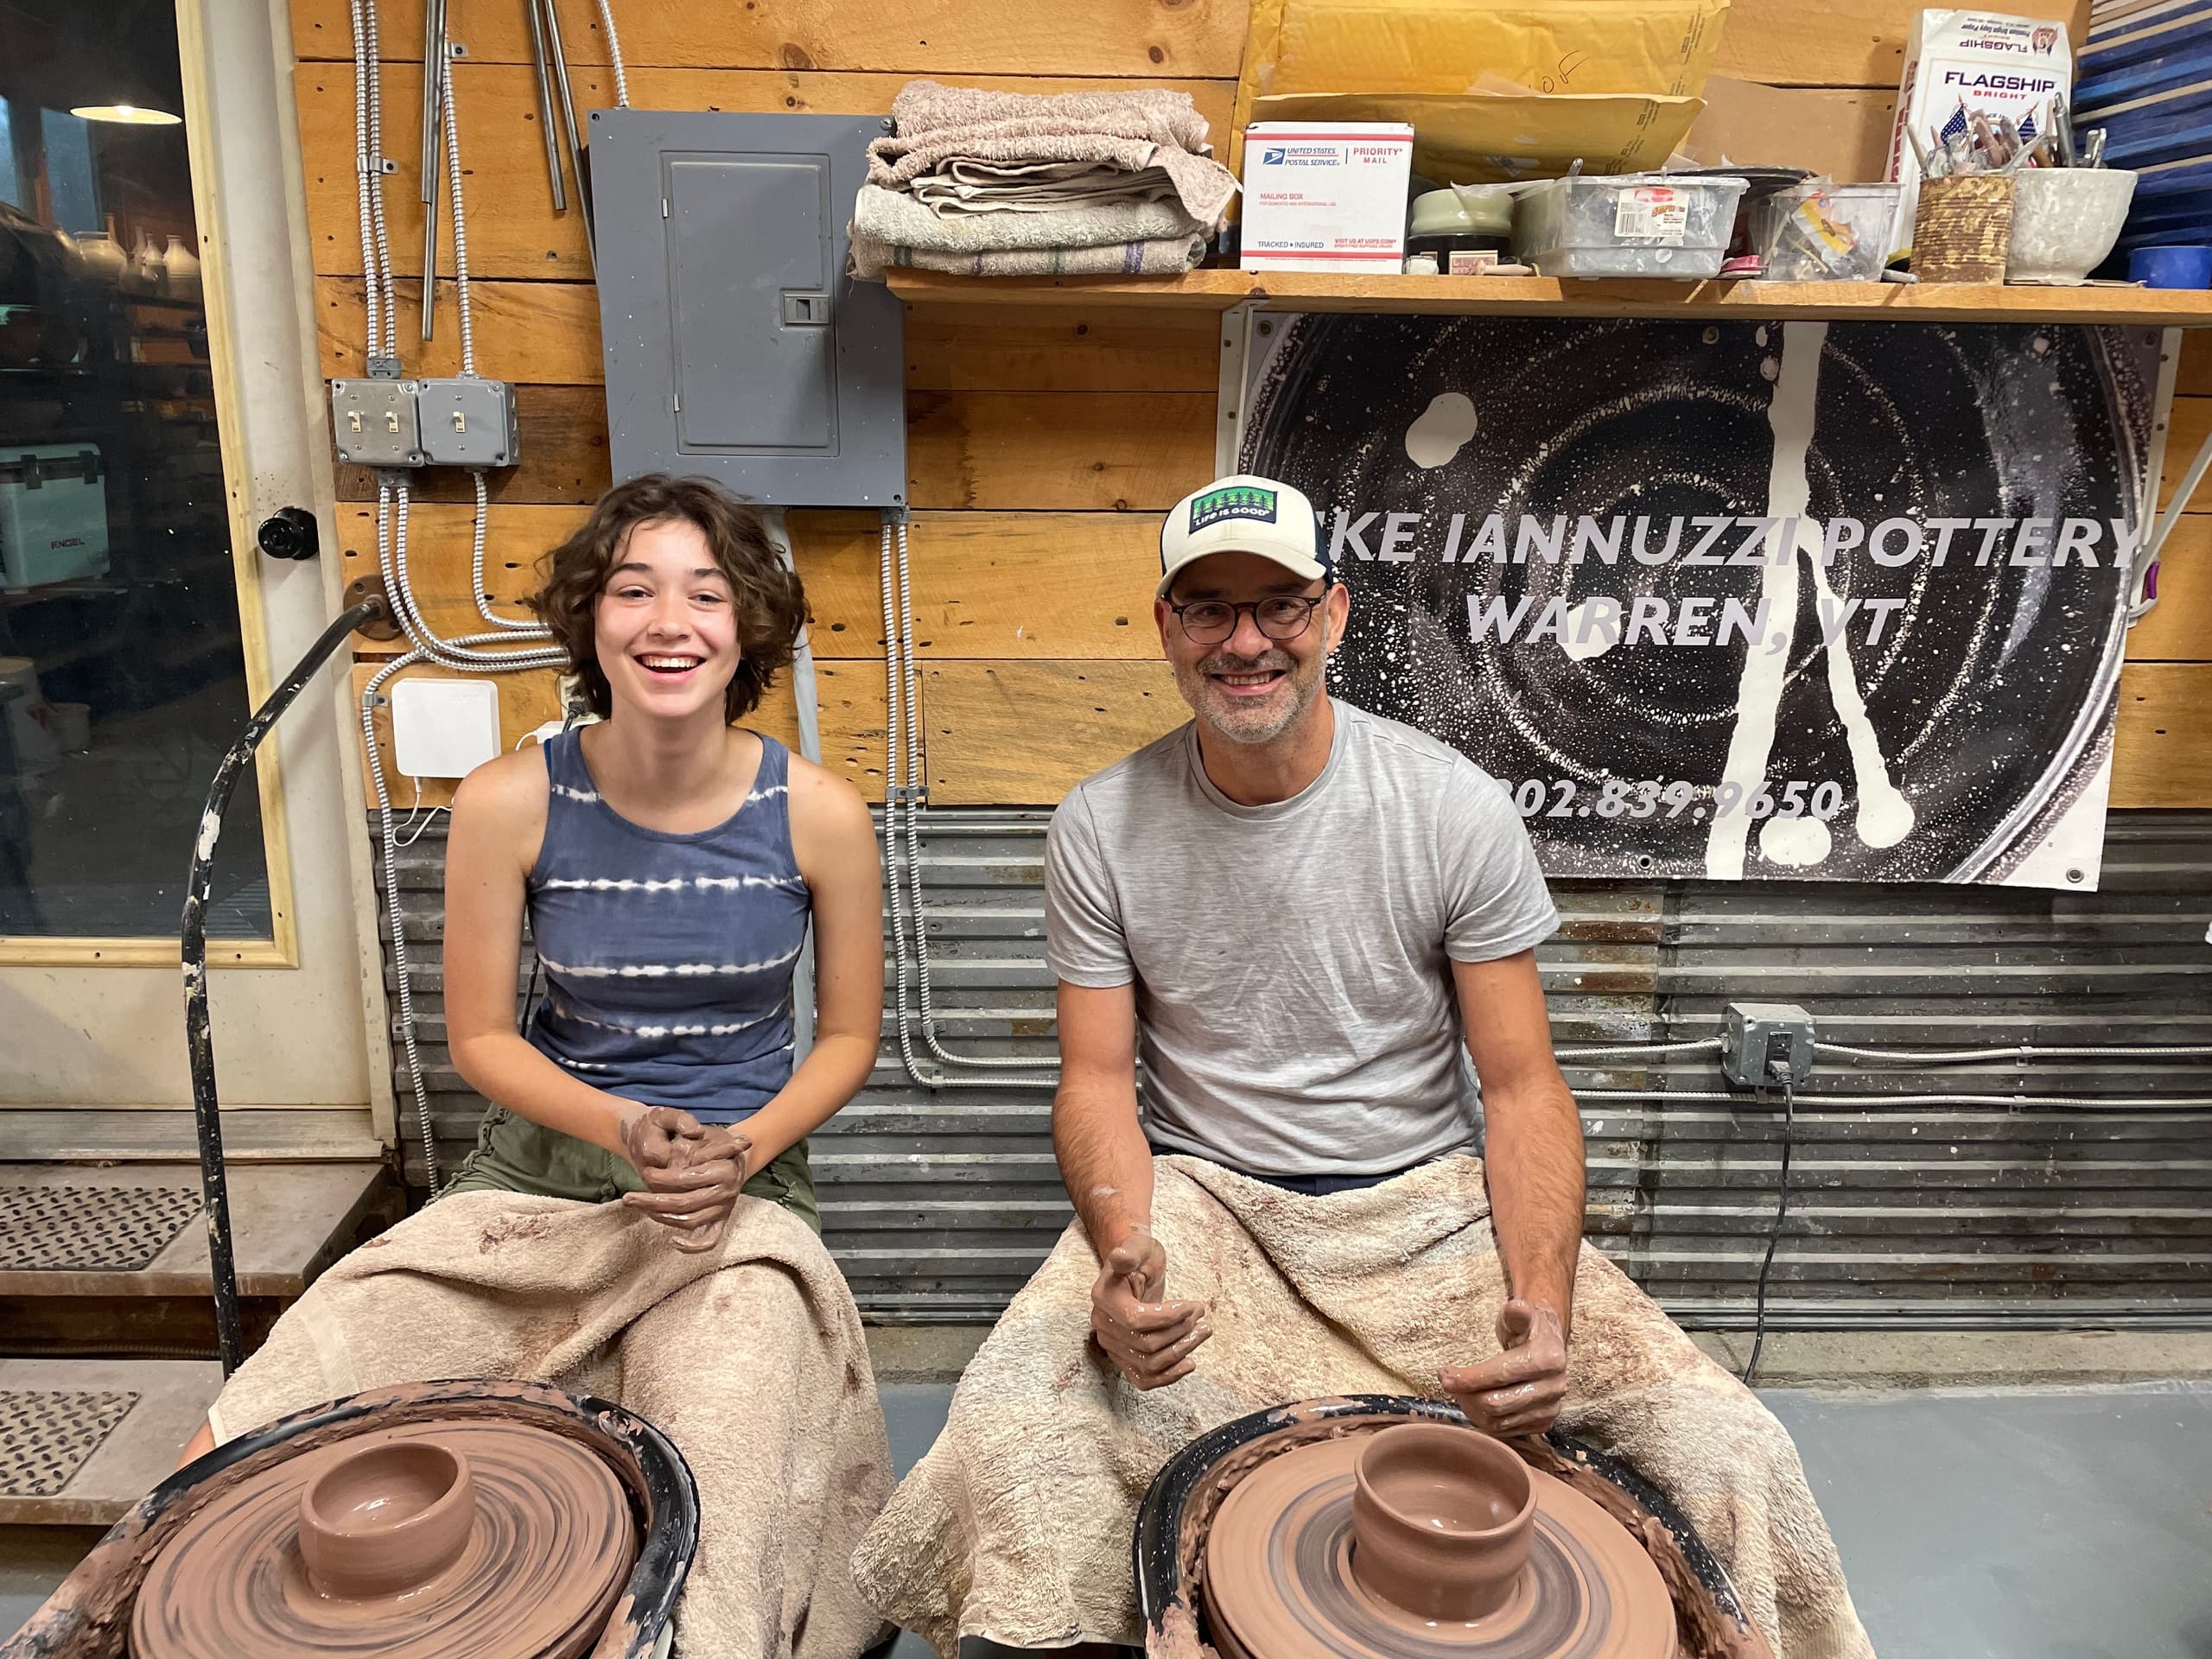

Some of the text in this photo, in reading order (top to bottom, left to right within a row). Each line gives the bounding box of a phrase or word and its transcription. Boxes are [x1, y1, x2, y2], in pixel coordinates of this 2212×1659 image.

[1959, 39, 2028, 53] FLAGSHIP
[1945, 72, 2055, 92] FLAGSHIP
[1974, 90, 2027, 100] BRIGHT
[1195, 512, 1217, 525] LIFE
[1315, 511, 2142, 568] KE IANNUZZI POTTERY
[1466, 595, 1906, 655] WARREN, VT
[1496, 779, 1842, 820] 02.839.9650
